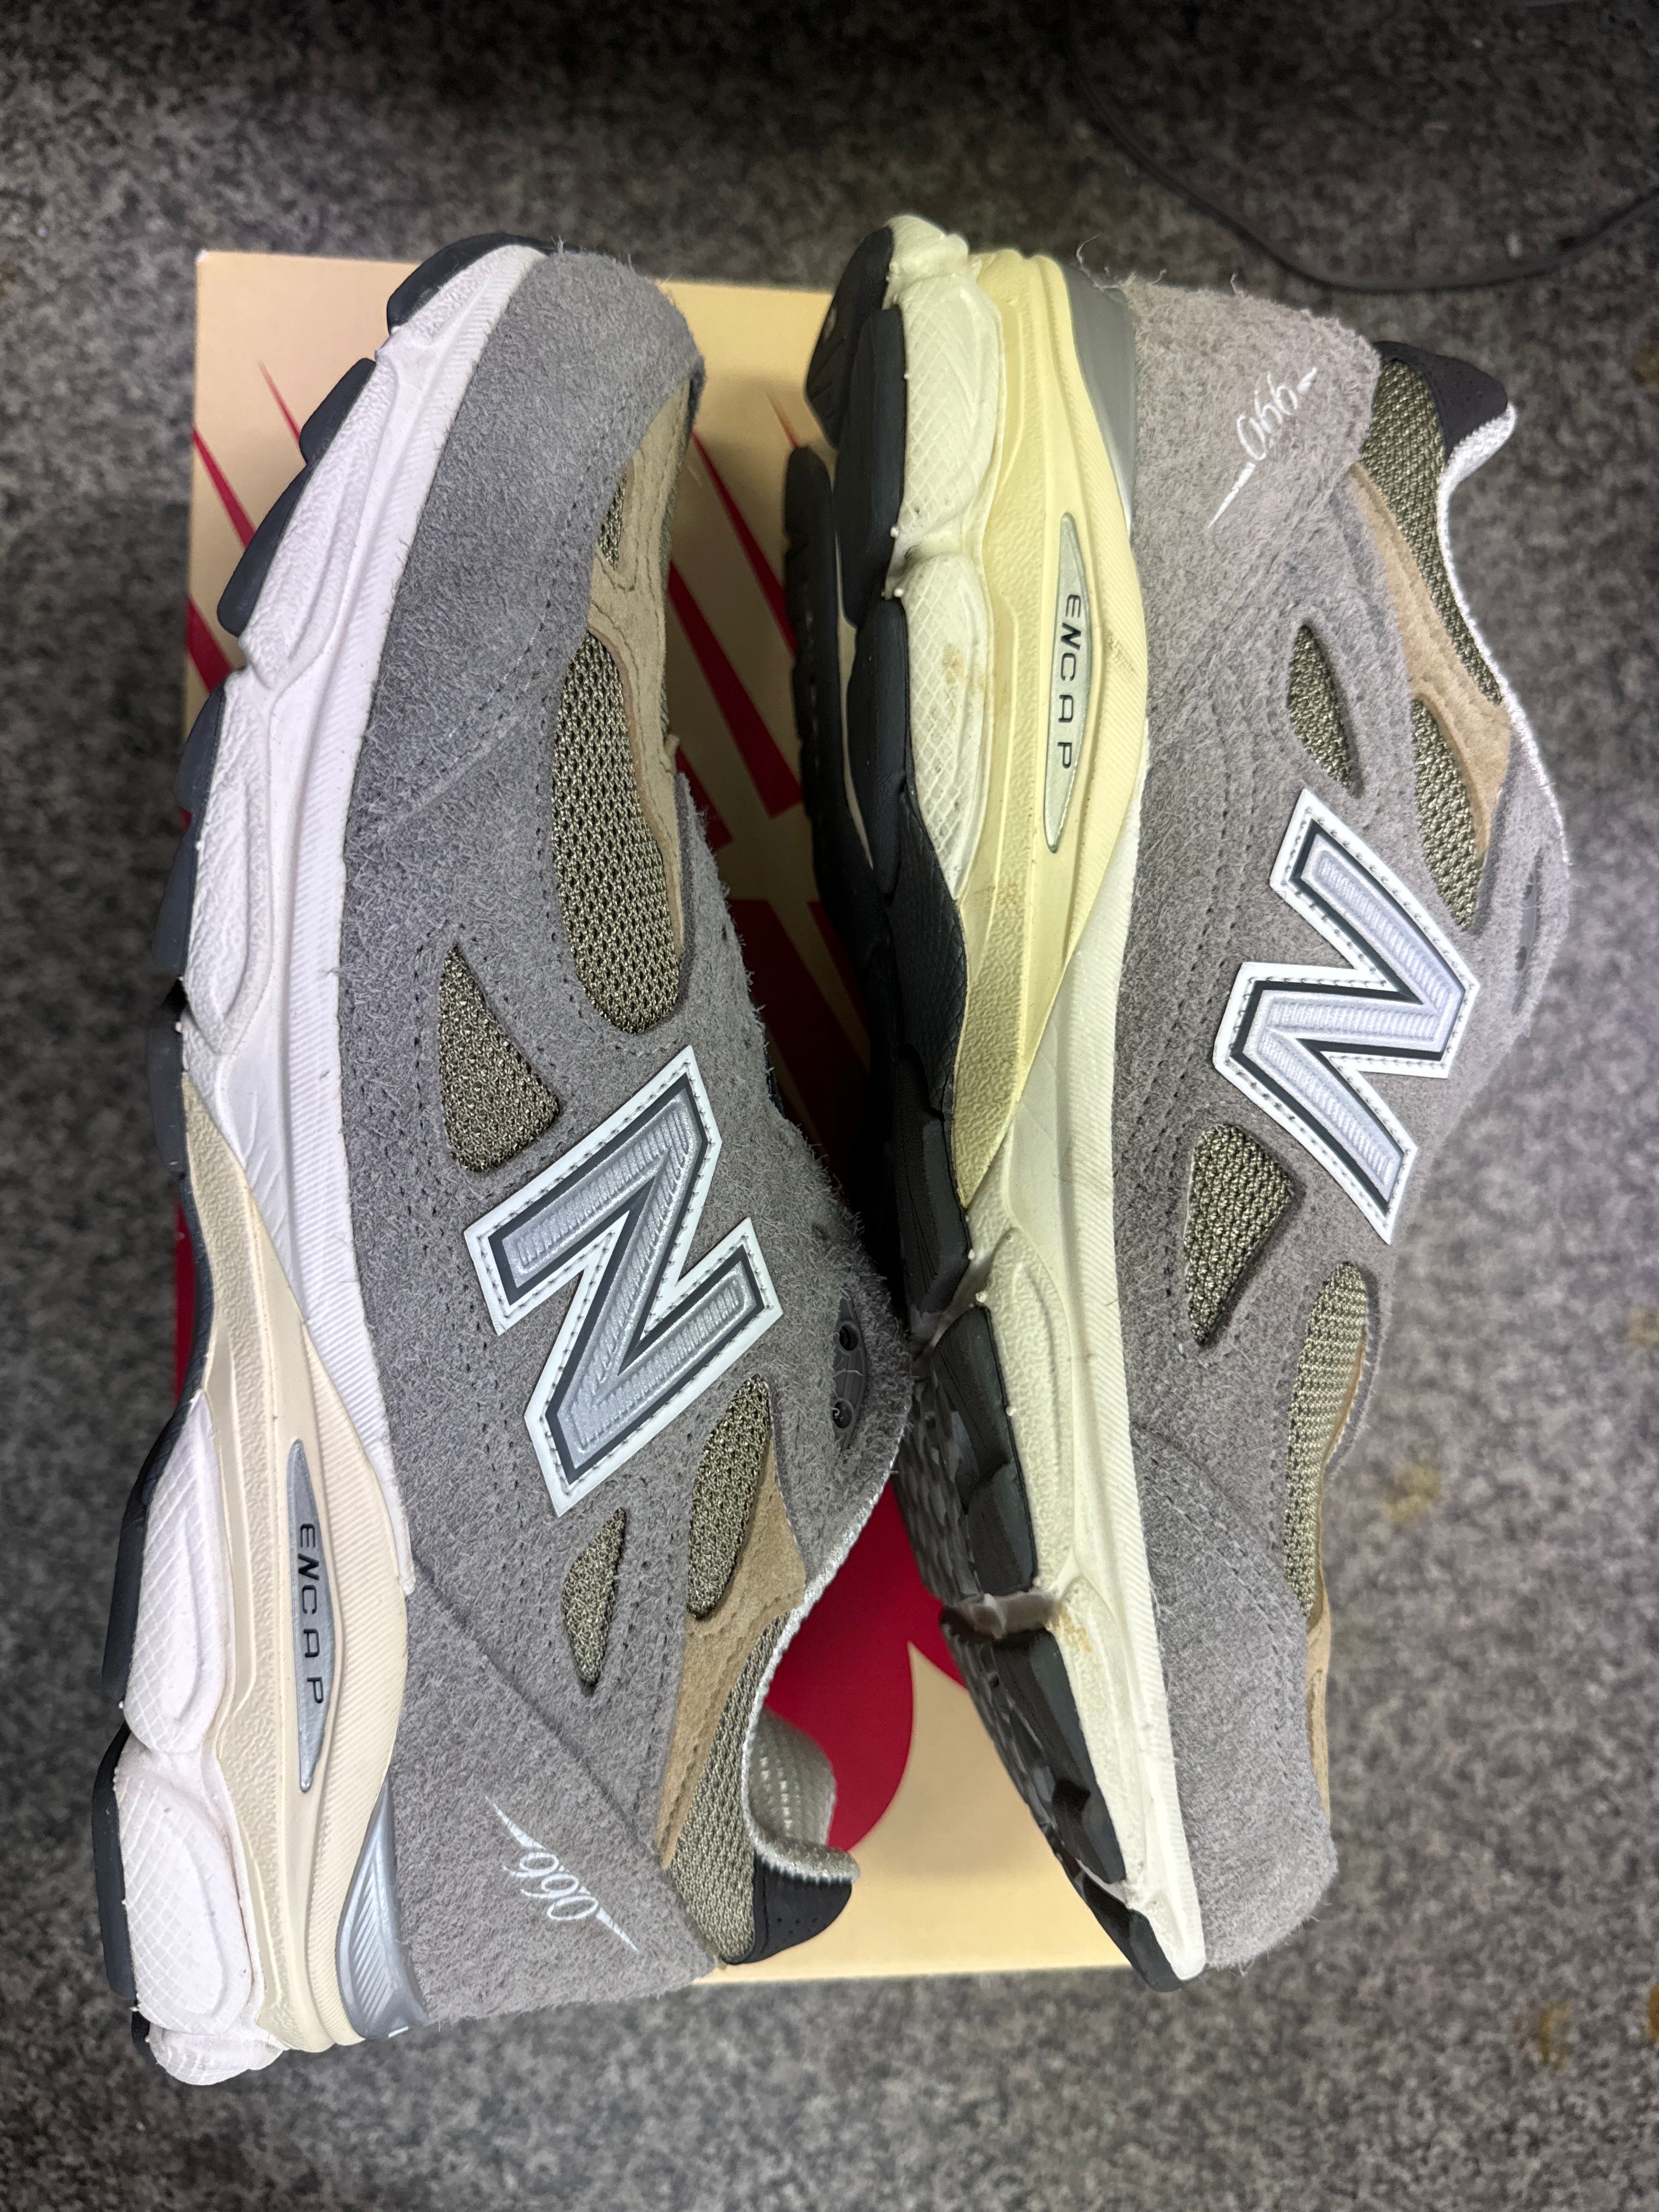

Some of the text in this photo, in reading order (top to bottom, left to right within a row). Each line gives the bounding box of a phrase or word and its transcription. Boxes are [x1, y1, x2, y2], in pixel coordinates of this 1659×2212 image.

[1057, 594, 1081, 769] ENCAP
[1212, 788, 1480, 1245] N
[464, 1044, 783, 1517] N
[298, 1523, 325, 1704] ENCAP
